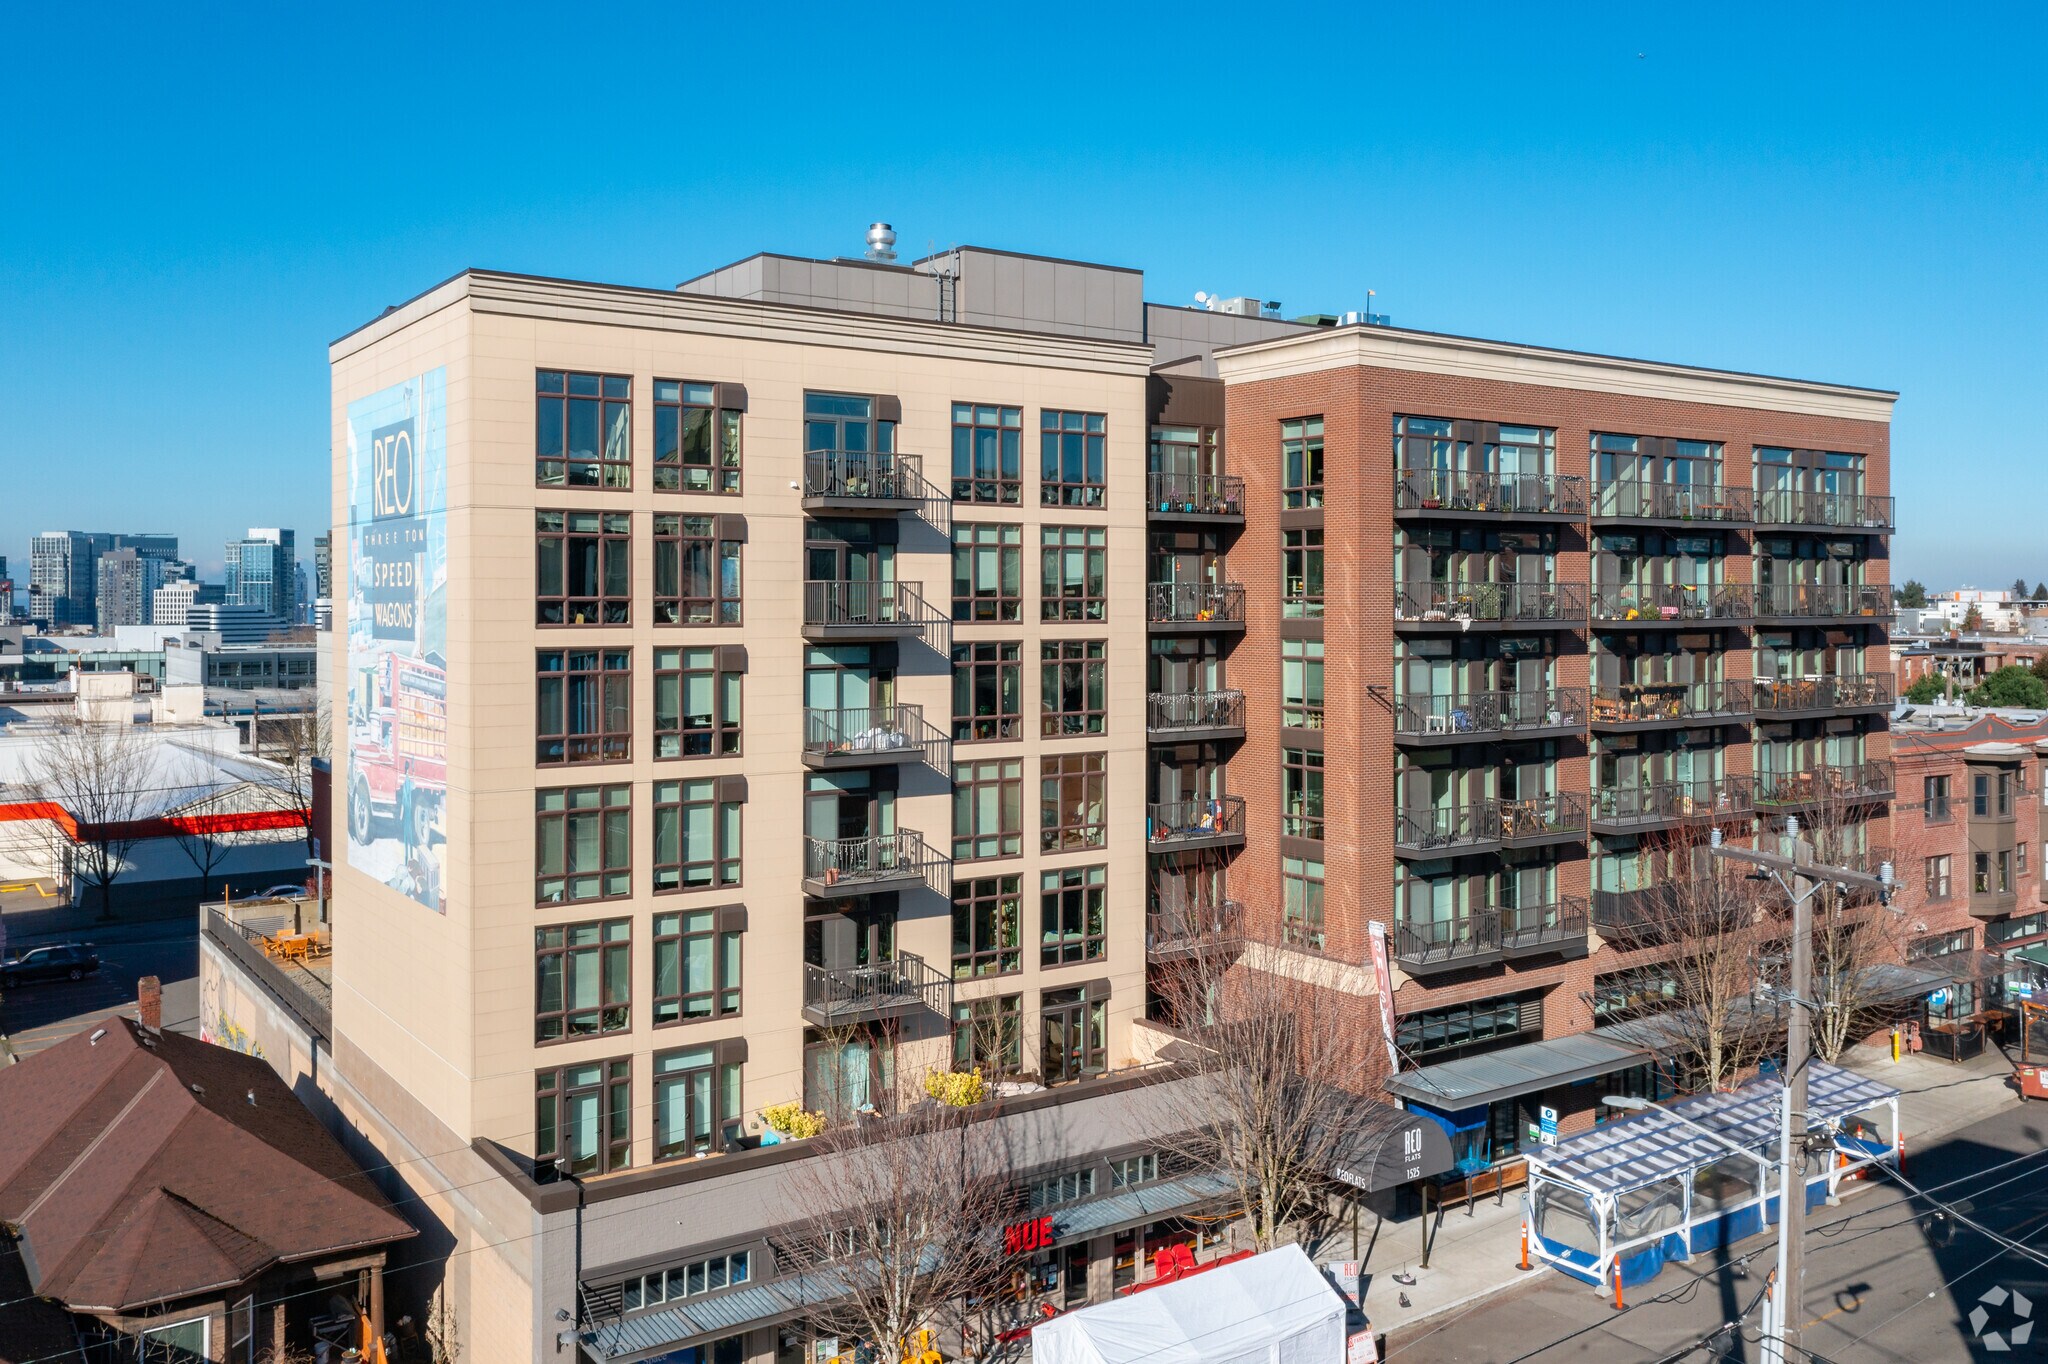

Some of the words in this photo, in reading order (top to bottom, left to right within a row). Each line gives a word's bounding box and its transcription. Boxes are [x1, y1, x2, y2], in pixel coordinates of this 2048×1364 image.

[374, 430, 413, 517] REO
[364, 531, 399, 546] THREE
[405, 528, 425, 544] TON
[374, 562, 413, 588] SPEED
[374, 602, 413, 629] WAGONS
[1404, 1127, 1422, 1155] REO
[1404, 1152, 1422, 1163] FLATS
[1406, 1166, 1420, 1180] 1525
[1005, 1214, 1053, 1256] NUE
[1344, 1263, 1359, 1277] REO
